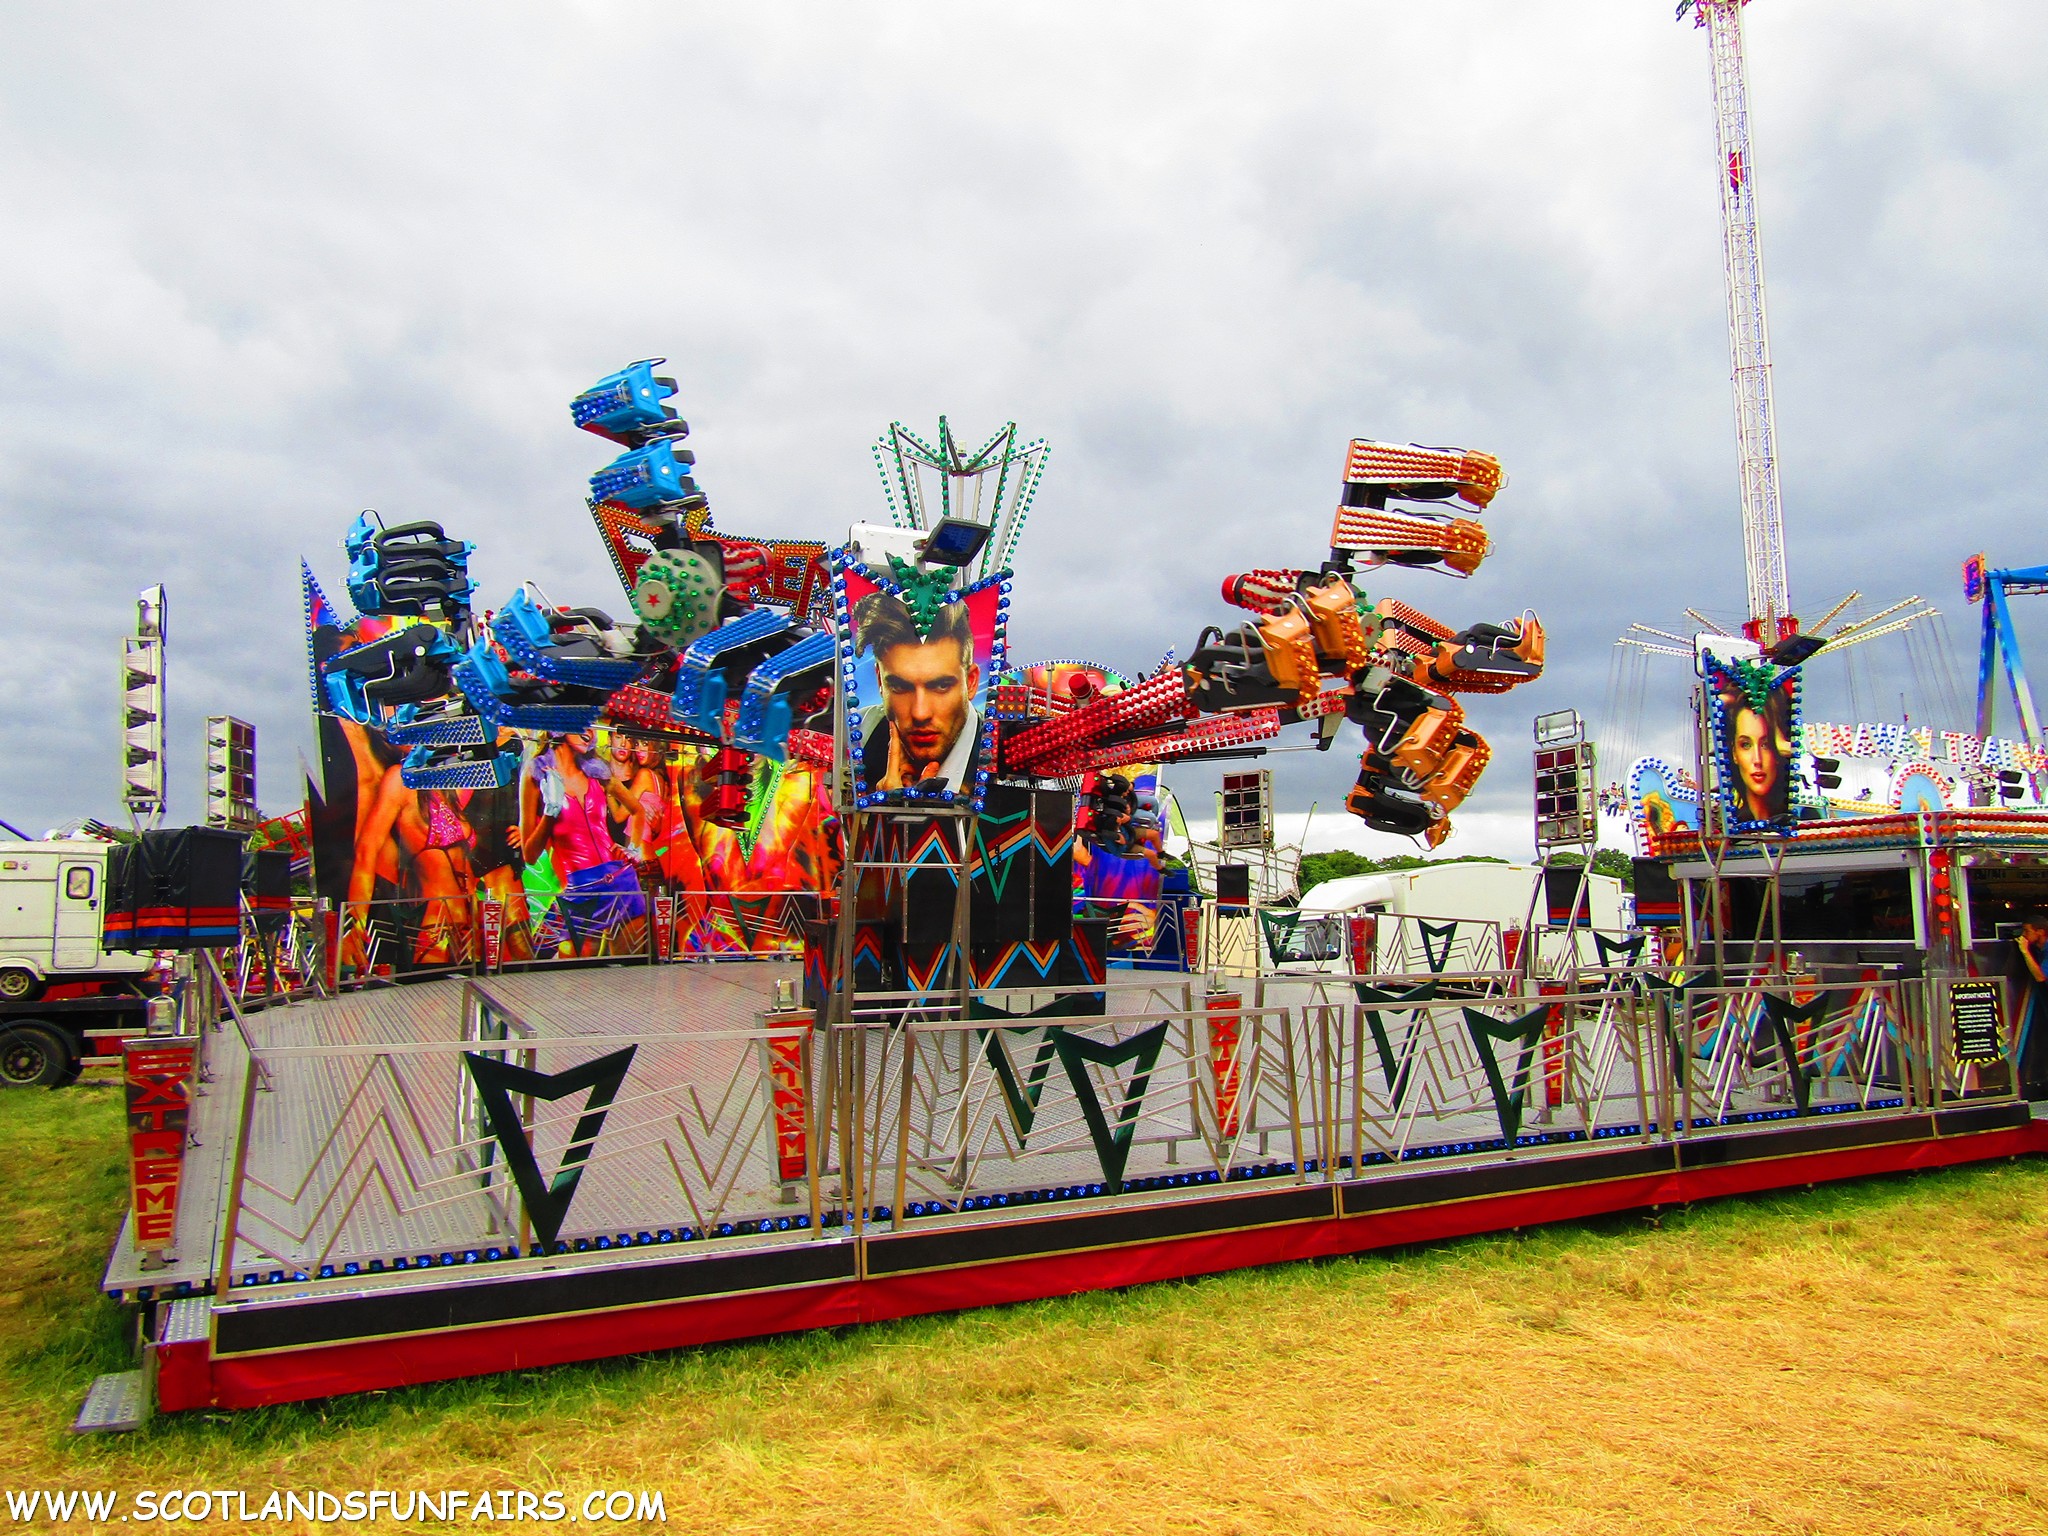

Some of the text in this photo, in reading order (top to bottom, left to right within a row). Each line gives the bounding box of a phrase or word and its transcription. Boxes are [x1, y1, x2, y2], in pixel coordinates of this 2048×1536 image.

[1940, 730, 2034, 773] TRAIN
[484, 903, 502, 967] EXTREME
[1183, 910, 1199, 965] EXTREME
[127, 1047, 194, 1241] EXTREME
